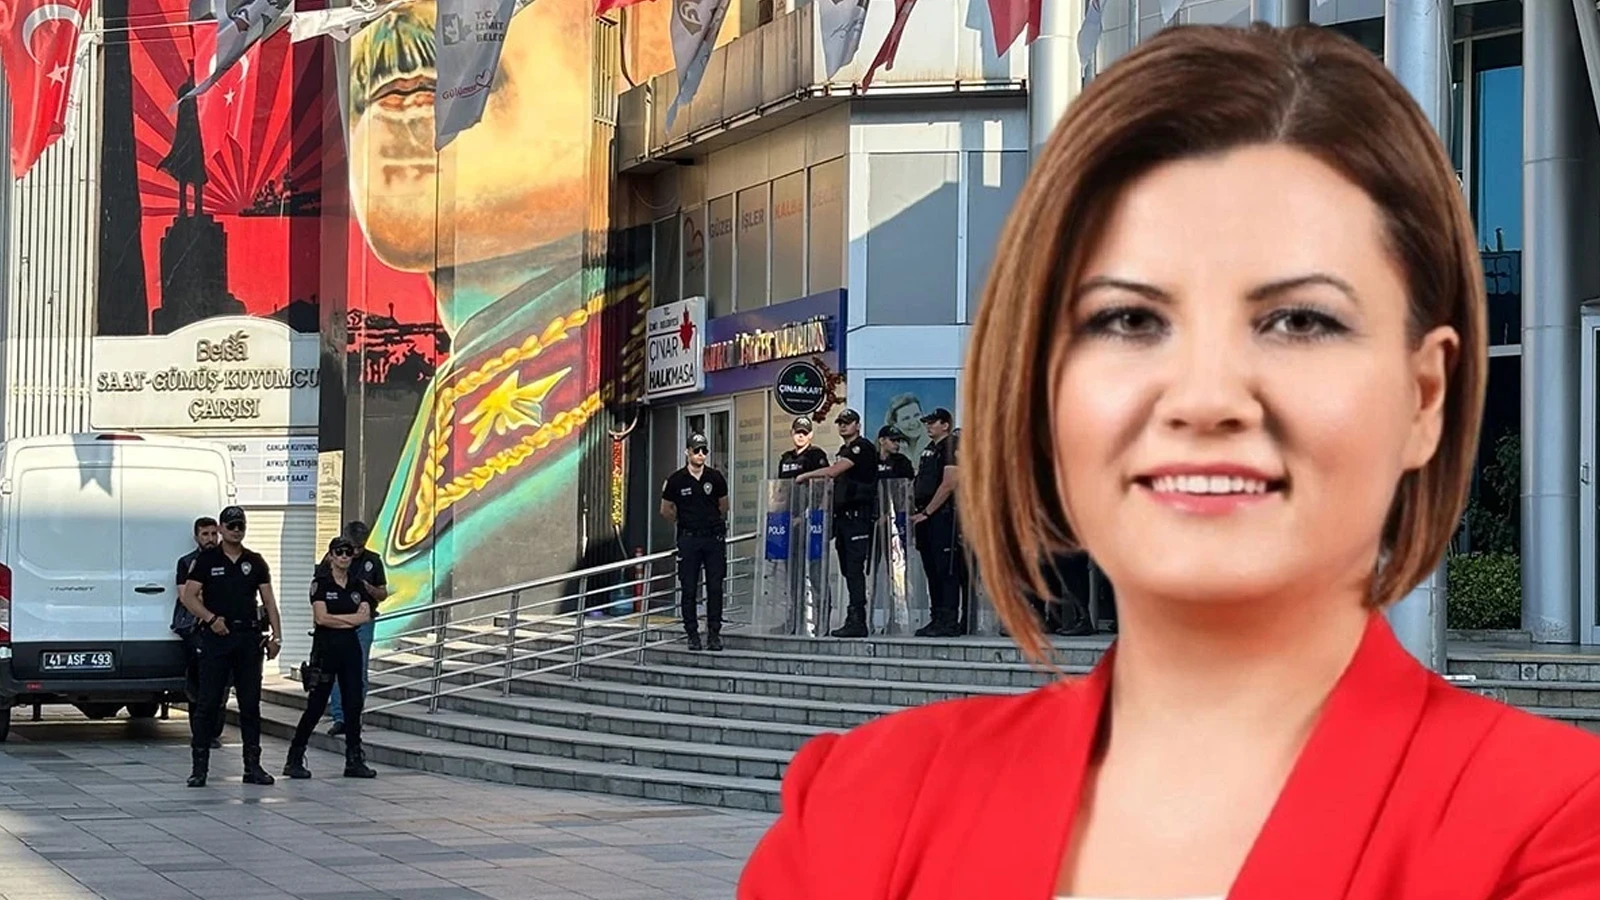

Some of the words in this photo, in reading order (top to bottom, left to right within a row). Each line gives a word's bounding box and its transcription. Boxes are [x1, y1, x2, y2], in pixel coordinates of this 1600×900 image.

[649, 362, 694, 389] HALKMASA
[188, 398, 261, 422] ÇARŞISI
[49, 654, 61, 665] 41
[67, 654, 87, 665] ASF
[91, 653, 111, 665] 493
